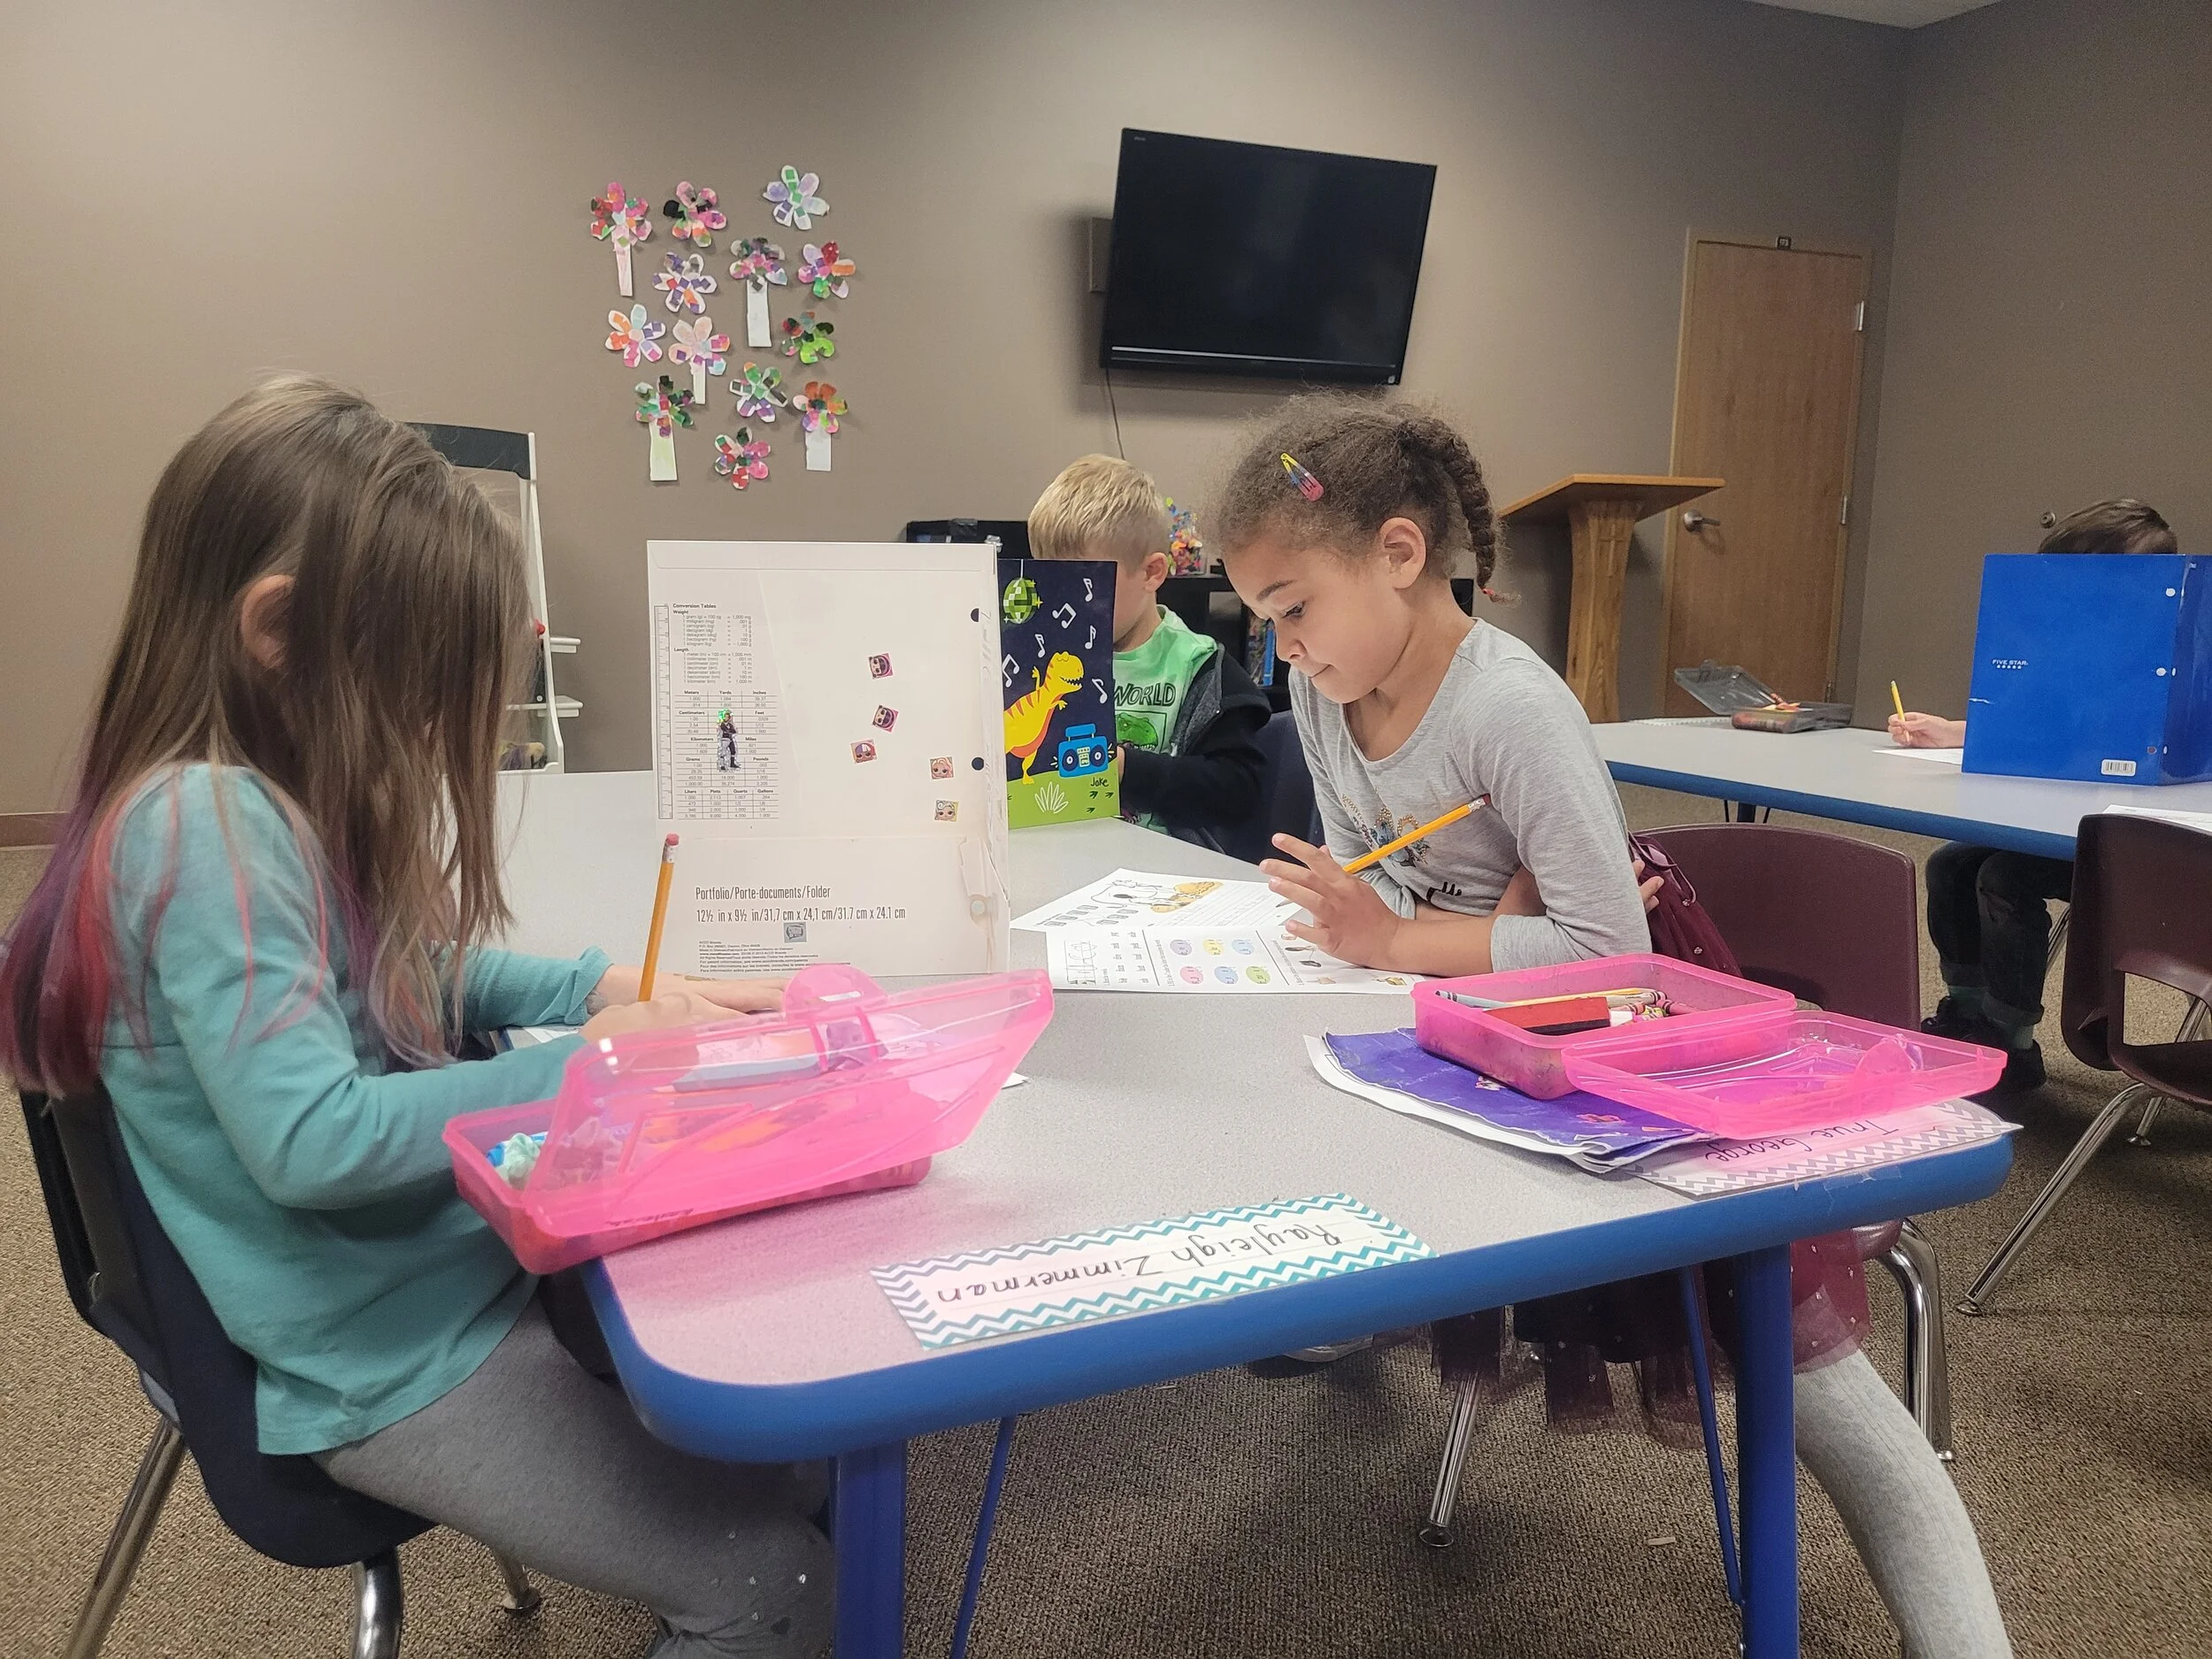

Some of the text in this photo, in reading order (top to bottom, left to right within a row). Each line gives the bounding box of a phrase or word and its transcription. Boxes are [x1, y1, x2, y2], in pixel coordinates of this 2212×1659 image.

[1114, 683, 1176, 707] WORLD
[1091, 777, 1109, 788] Jake
[696, 886, 831, 900] Portfolio/Porte-documents/Folder
[718, 909, 726, 922] in
[728, 912, 732, 921] x
[752, 908, 780, 922] in/31,7
[783, 911, 794, 921] cm
[796, 912, 800, 921] x
[803, 908, 818, 921] 24,1
[822, 907, 853, 920] cm/31.7
[856, 911, 867, 919] cm
[870, 911, 874, 919] x
[877, 907, 891, 919] 24.1
[894, 910, 905, 919] cm
[1705, 1119, 1899, 1165] True George
[937, 1223, 1340, 1306] Rayleigh Zimmerman
